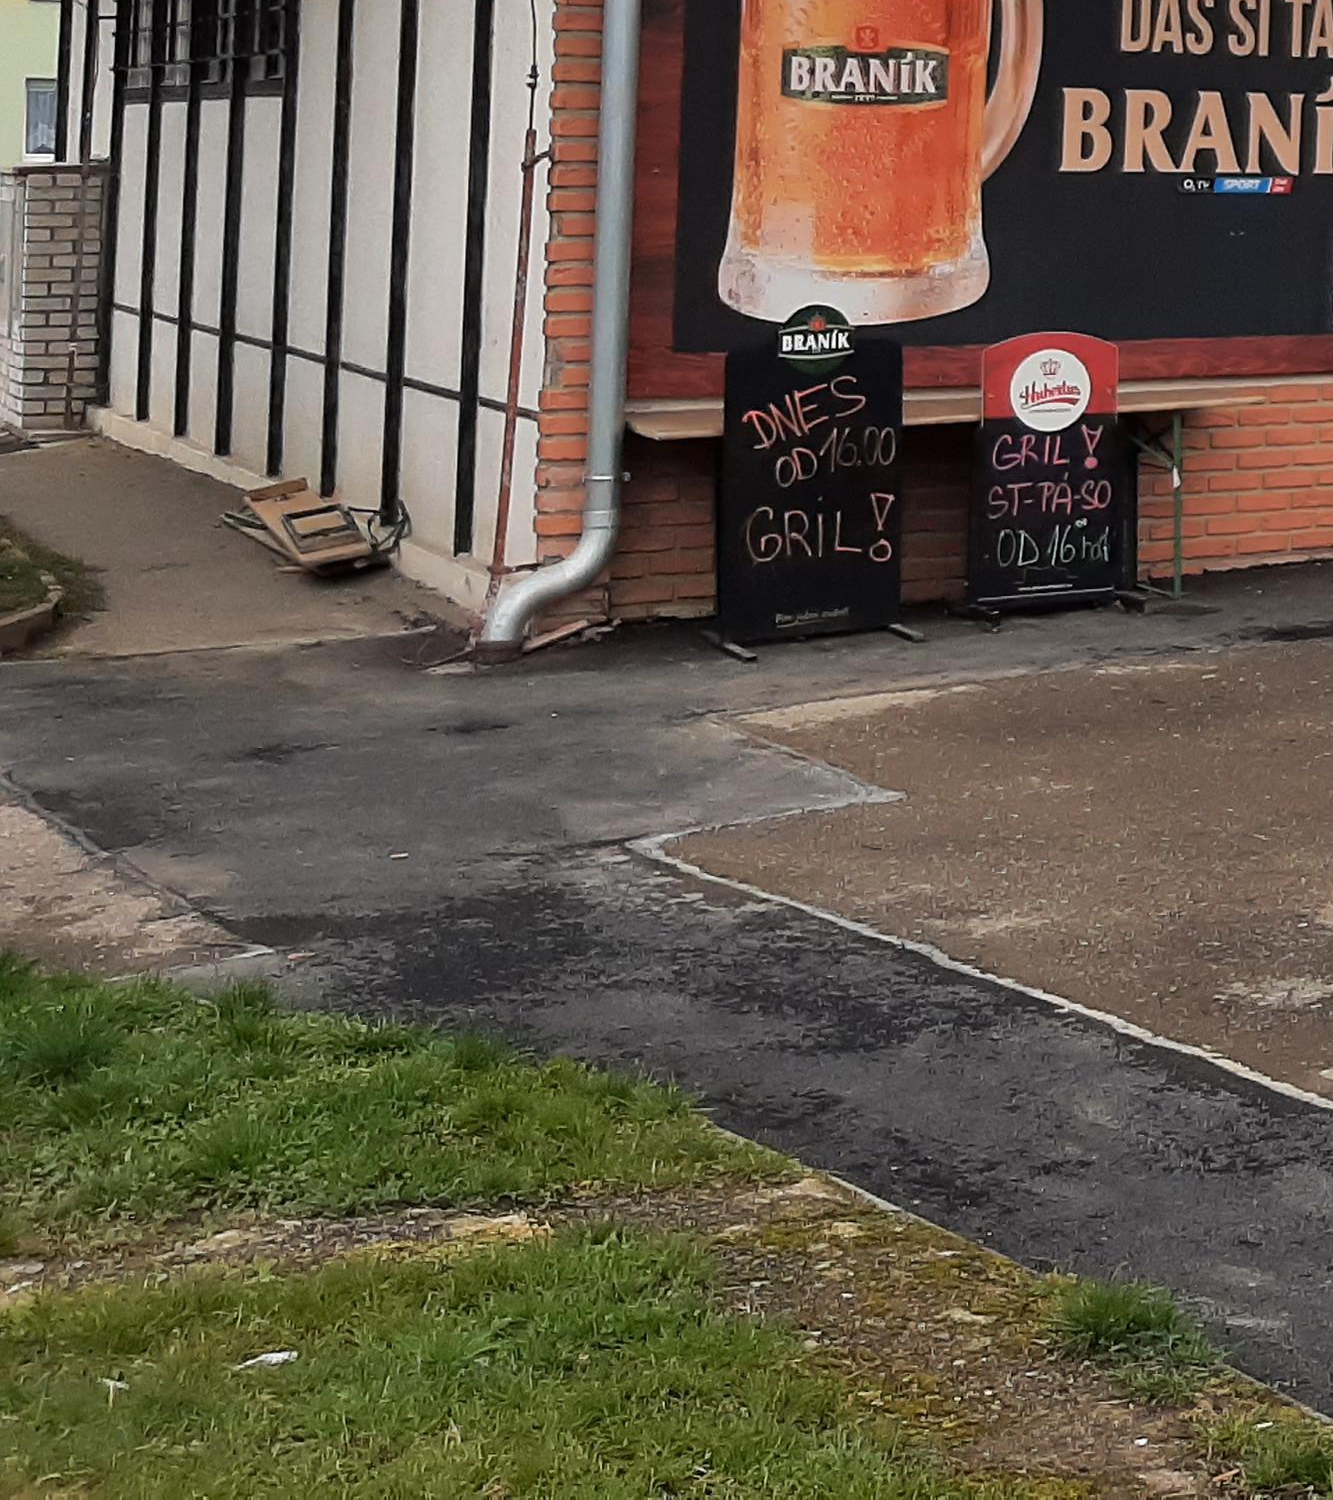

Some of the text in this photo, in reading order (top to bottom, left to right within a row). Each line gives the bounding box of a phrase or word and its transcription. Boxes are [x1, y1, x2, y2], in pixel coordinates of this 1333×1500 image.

[790, 52, 937, 93] BRANÍK
[781, 330, 850, 352] BRANÍK
[742, 375, 867, 450] DNES
[775, 447, 818, 488] OD
[997, 528, 1040, 567] OD
